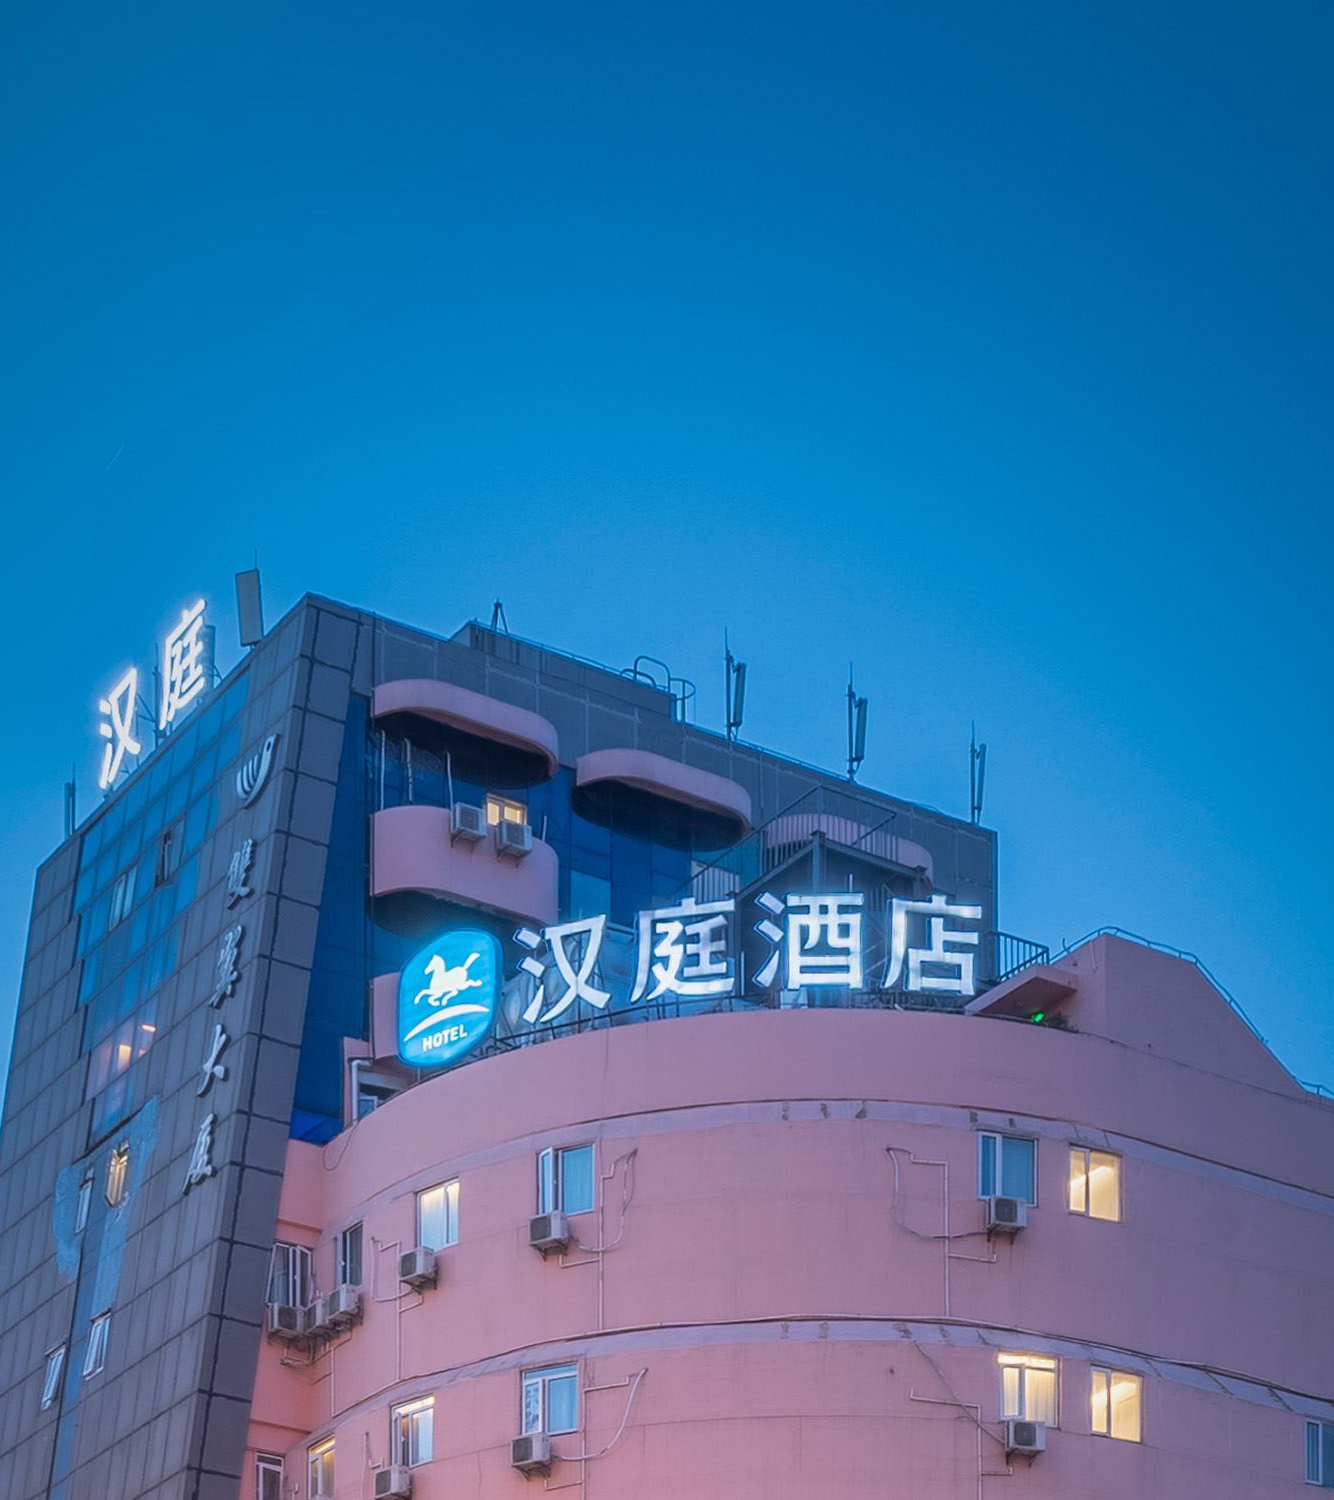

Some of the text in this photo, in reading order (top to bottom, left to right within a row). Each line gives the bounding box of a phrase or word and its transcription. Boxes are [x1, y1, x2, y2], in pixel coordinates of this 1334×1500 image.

[99, 598, 205, 789] 汉庭
[513, 891, 982, 1025] 汉庭酒店
[422, 1023, 468, 1051] HOTEL
